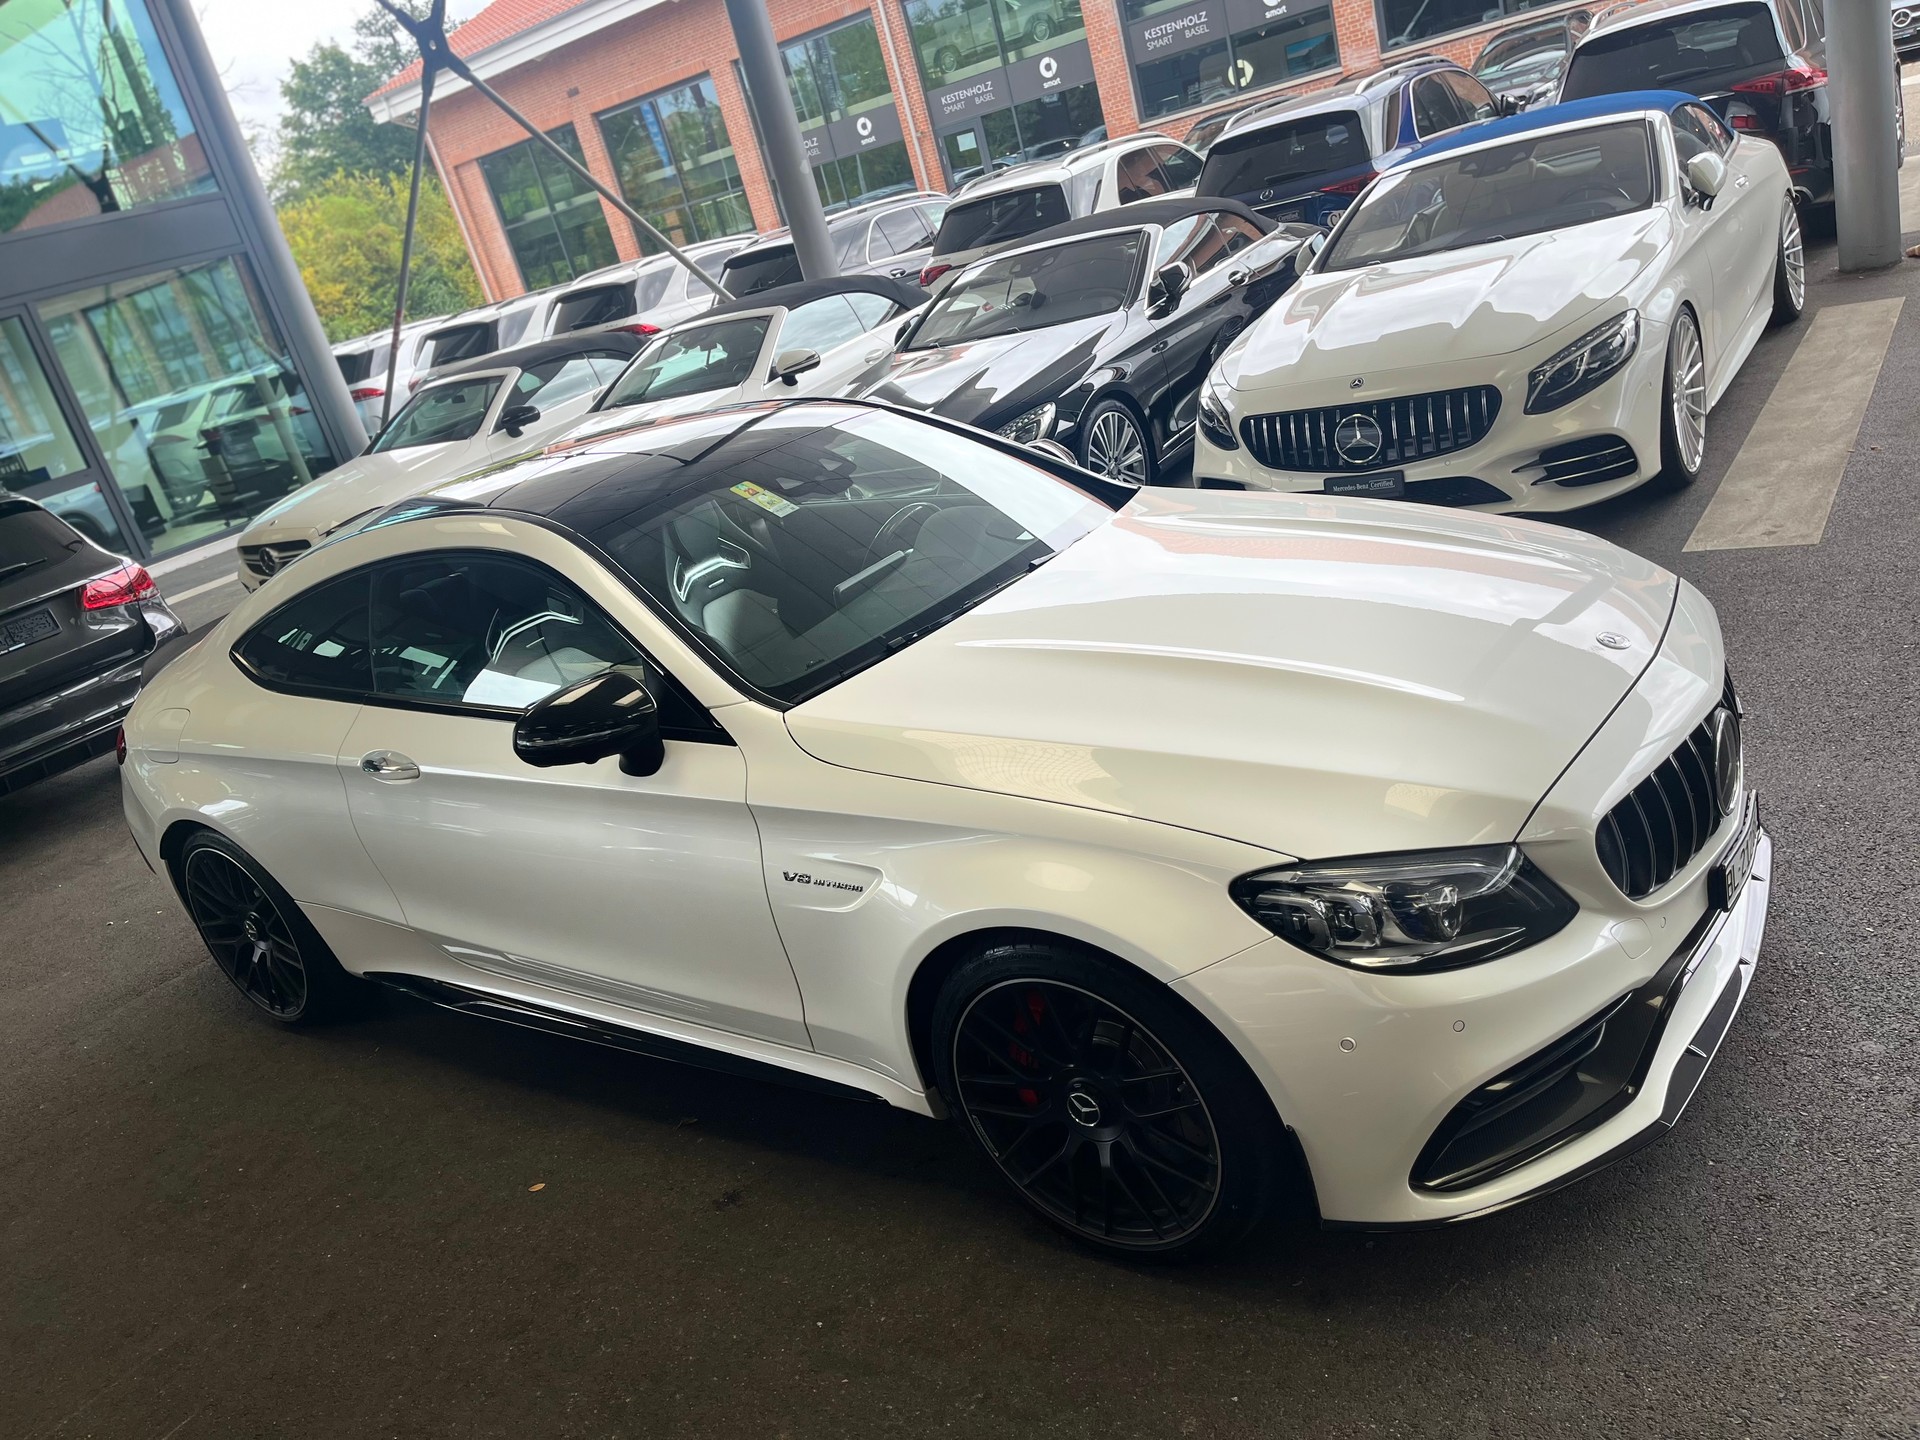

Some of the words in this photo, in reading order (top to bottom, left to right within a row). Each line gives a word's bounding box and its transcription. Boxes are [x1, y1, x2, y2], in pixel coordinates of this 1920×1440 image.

[1265, 5, 1287, 19] smart
[1144, 11, 1208, 40] KESTENHOLZ
[1146, 35, 1173, 51] SMART
[1184, 24, 1210, 39] BASEL
[1043, 77, 1061, 89] smart
[941, 81, 993, 105] KESTENHOLZ
[943, 101, 966, 115] SMART
[974, 92, 996, 105] BASEL
[803, 138, 818, 148] OLZ
[807, 148, 820, 156] ASEL
[1370, 480, 1394, 489] Certified
[783, 871, 811, 884] V8
